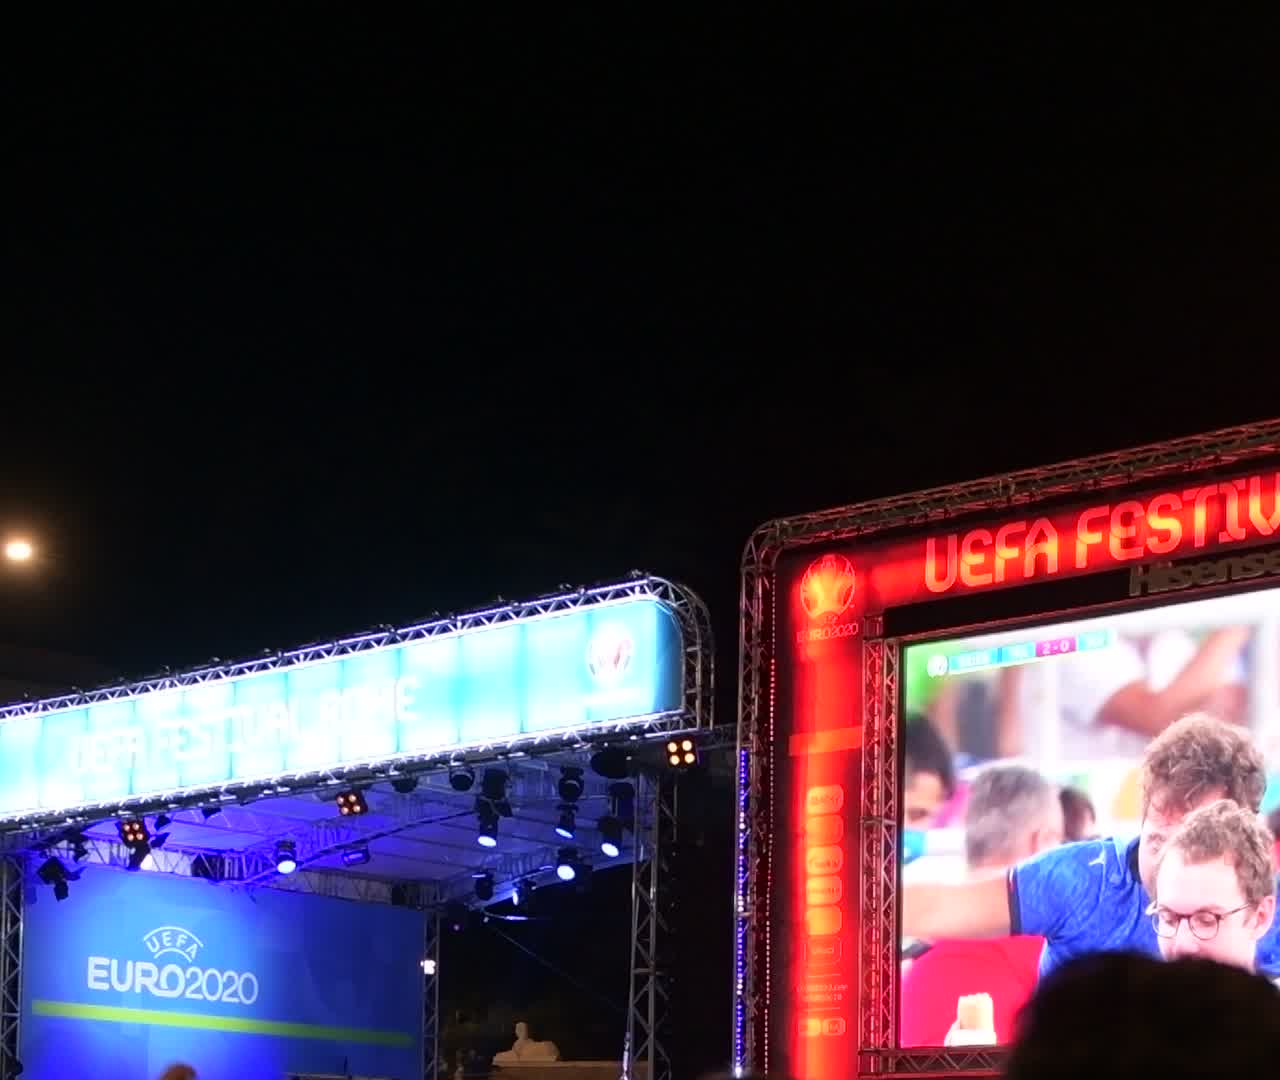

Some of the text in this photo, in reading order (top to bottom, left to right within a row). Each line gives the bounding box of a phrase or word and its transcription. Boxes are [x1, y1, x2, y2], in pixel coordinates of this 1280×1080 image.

[924, 517, 1058, 592] UEFA
[146, 931, 198, 959] UEFA
[87, 956, 259, 1004] EURO2020
